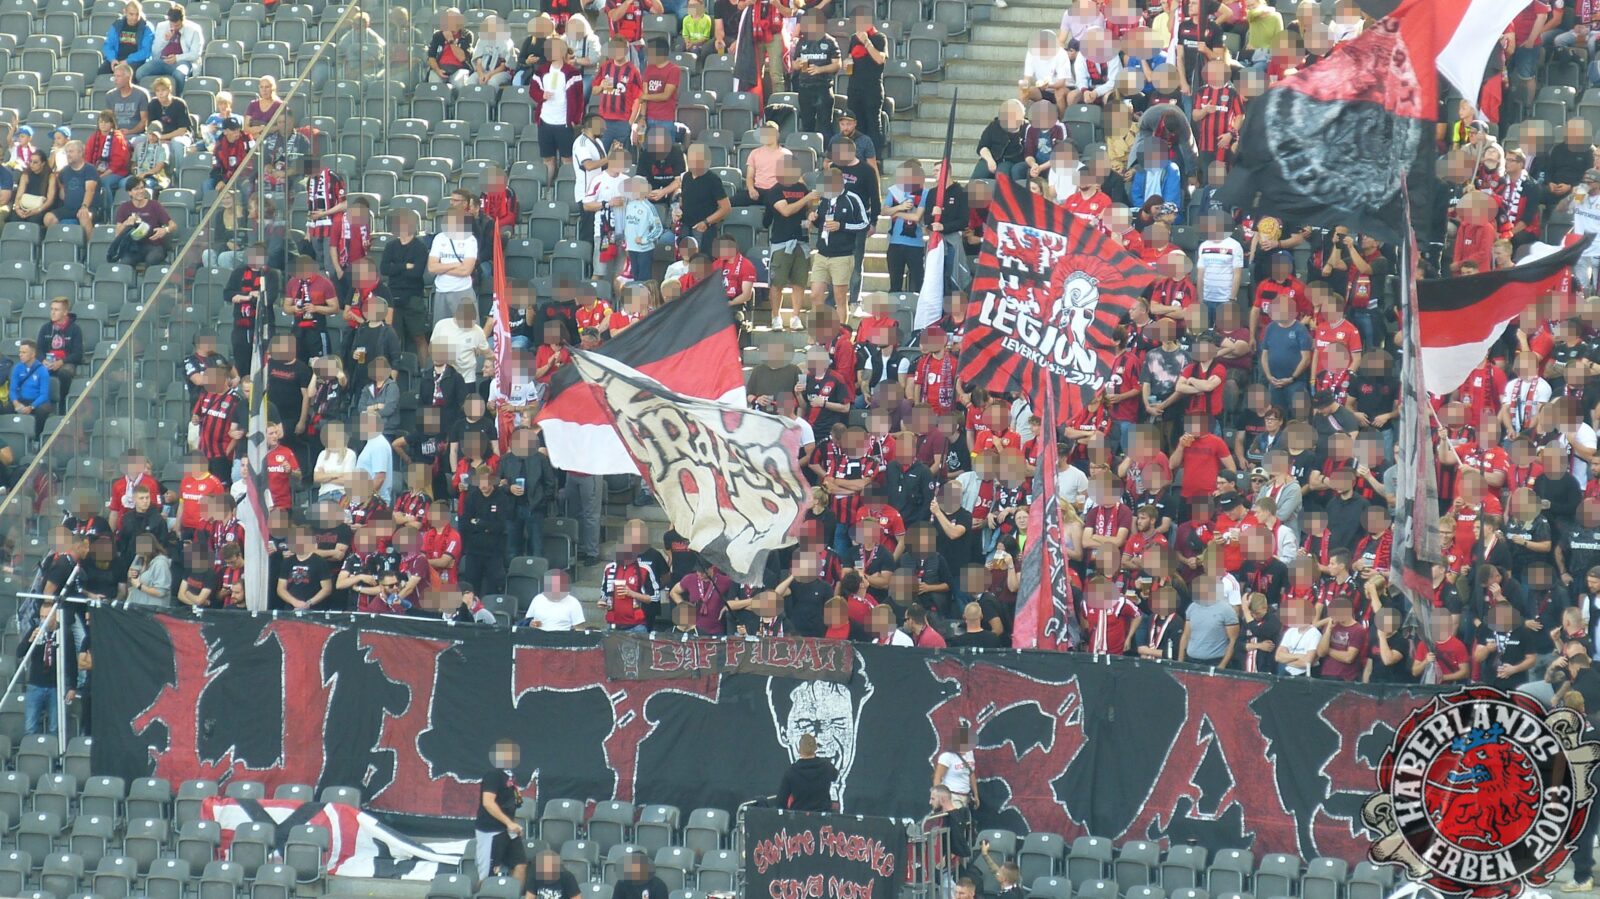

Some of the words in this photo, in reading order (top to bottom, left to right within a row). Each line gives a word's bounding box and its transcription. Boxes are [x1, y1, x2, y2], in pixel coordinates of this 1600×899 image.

[979, 292, 1098, 374] LEGION
[1001, 337, 1068, 377] LEVERKUSEN
[201, 406, 226, 419] Bamenia
